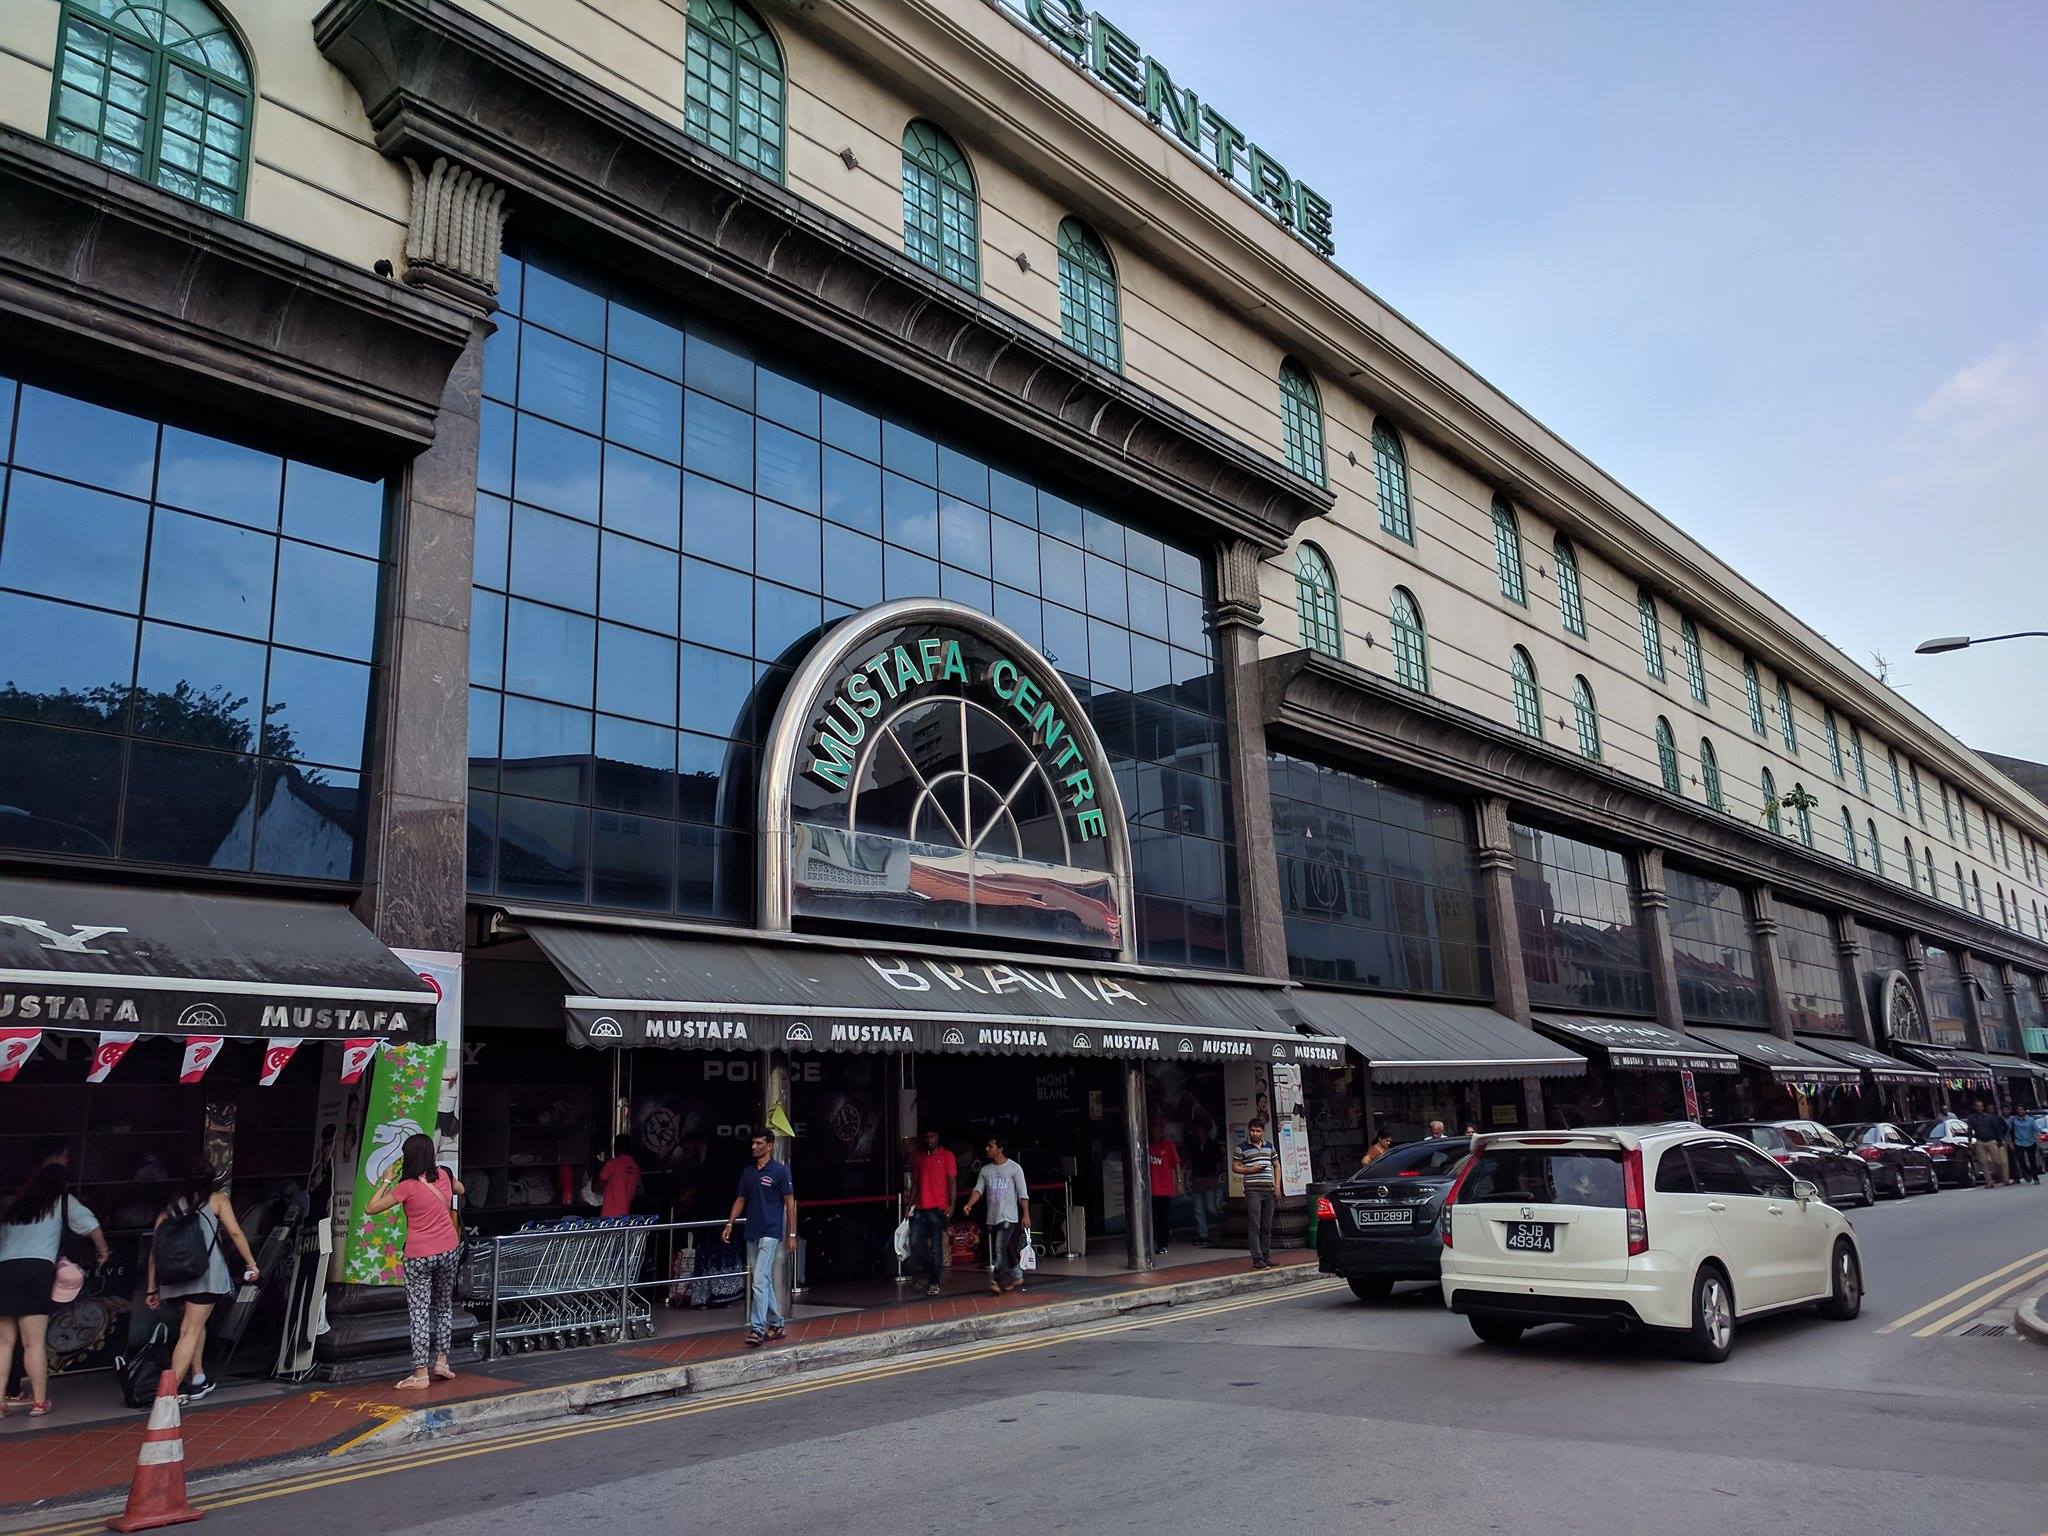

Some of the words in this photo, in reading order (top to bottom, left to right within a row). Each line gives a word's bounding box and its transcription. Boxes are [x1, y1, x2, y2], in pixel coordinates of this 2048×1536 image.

[1025, 0, 1335, 257] CENTRE
[805, 638, 968, 792] MUSTAFA
[990, 658, 1108, 842] CENTRE
[259, 1004, 409, 1032] MUSTAFA
[645, 1019, 748, 1040] MUSTAFA
[831, 1024, 914, 1043] MUSTAFA
[978, 1029, 1048, 1047] MUSTAFA
[1102, 1034, 1160, 1051] MUSTAFA
[1202, 1039, 1253, 1056] MUSTAFA
[1293, 1045, 1338, 1061] MUSTAFA
[1035, 1073, 1068, 1087] MONT
[1036, 1087, 1070, 1100] BLANC
[1360, 1210, 1411, 1223] SLD1289P
[1518, 1224, 1544, 1236] SJB
[1508, 1234, 1552, 1250] 4934A
